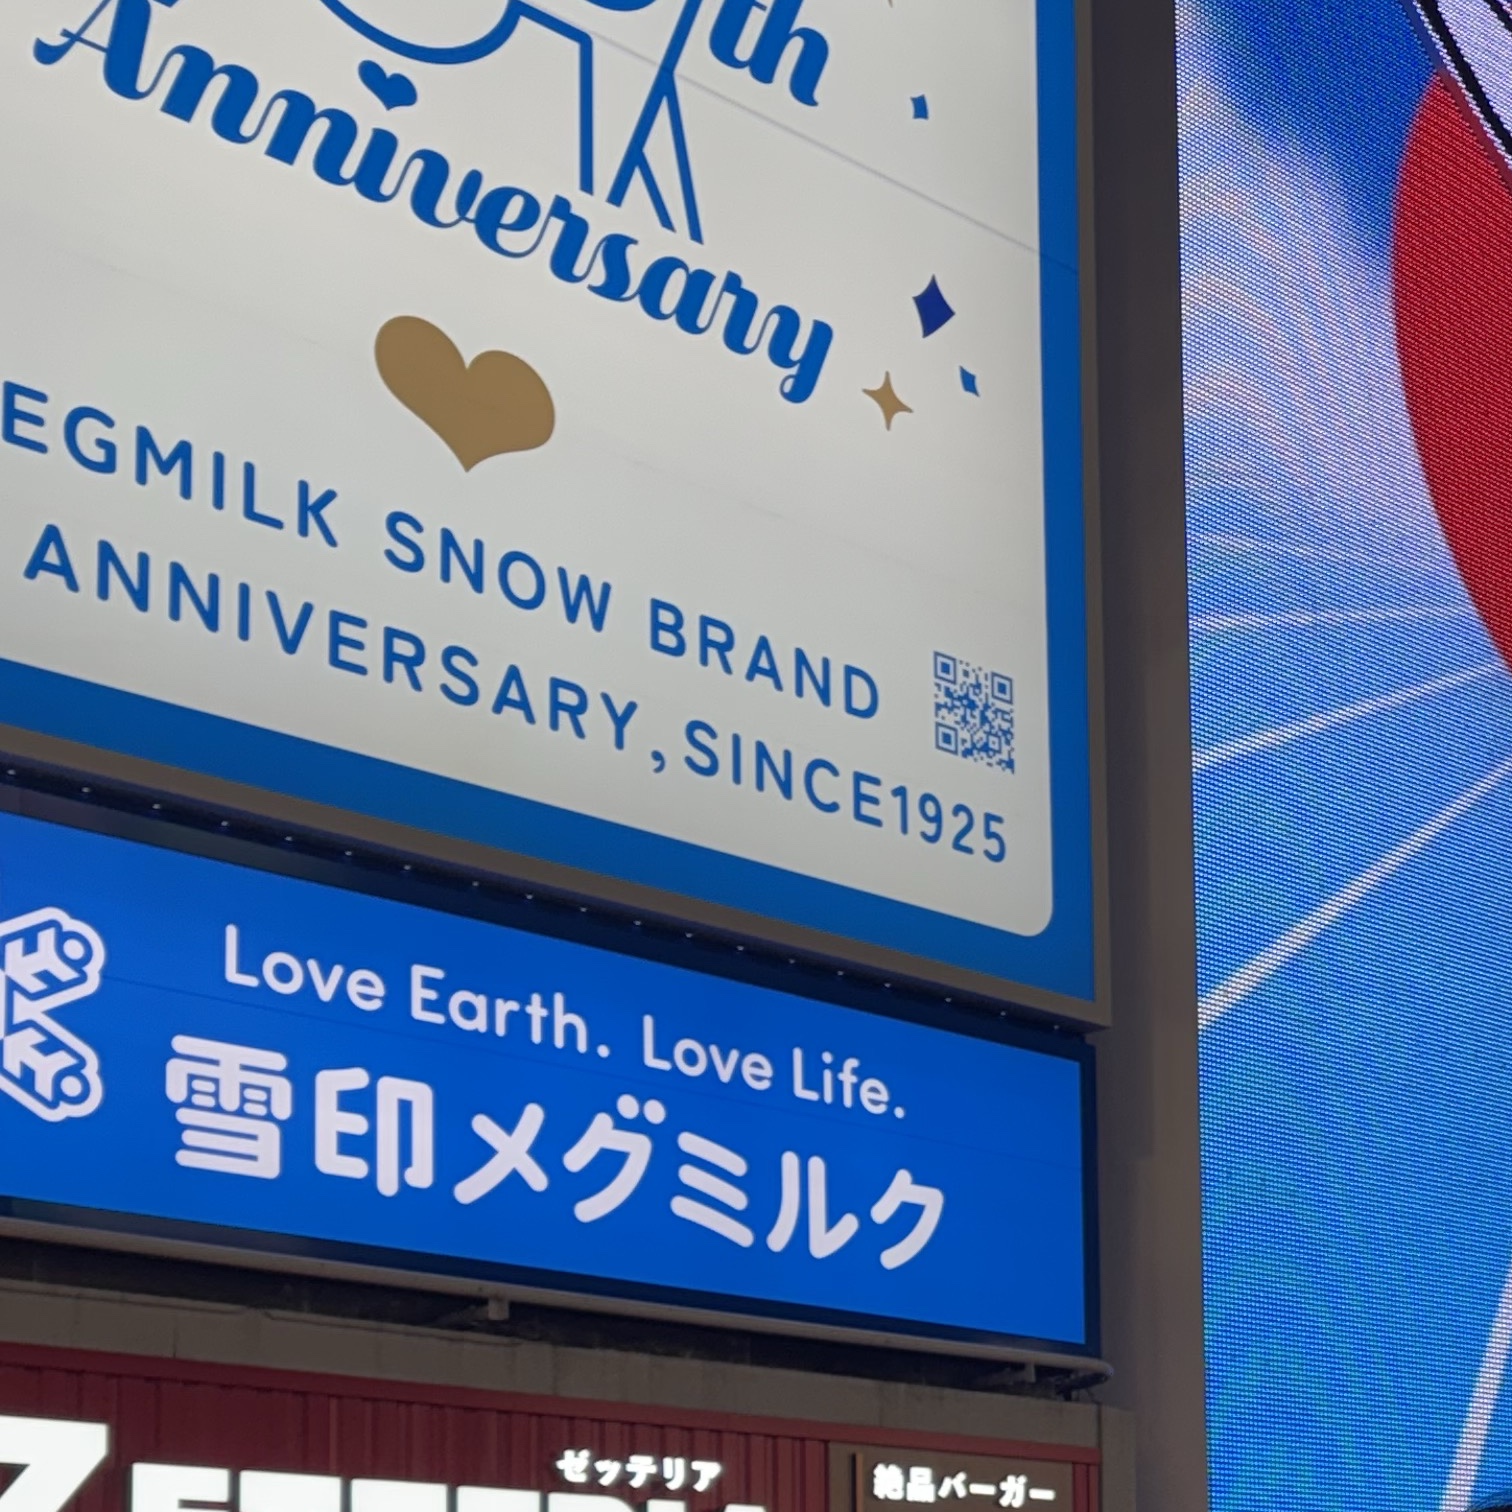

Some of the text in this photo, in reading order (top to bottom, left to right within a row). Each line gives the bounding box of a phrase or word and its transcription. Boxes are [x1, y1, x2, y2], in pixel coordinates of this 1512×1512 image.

[33, 0, 833, 403] Anniversary
[1, 381, 880, 719] EGMILK SNOW BRAND
[225, 924, 907, 1119] Love Earth. Love Life.
[166, 1034, 945, 1272] 雪印メグミルク
[555, 1447, 723, 1491] ゼッテリア
